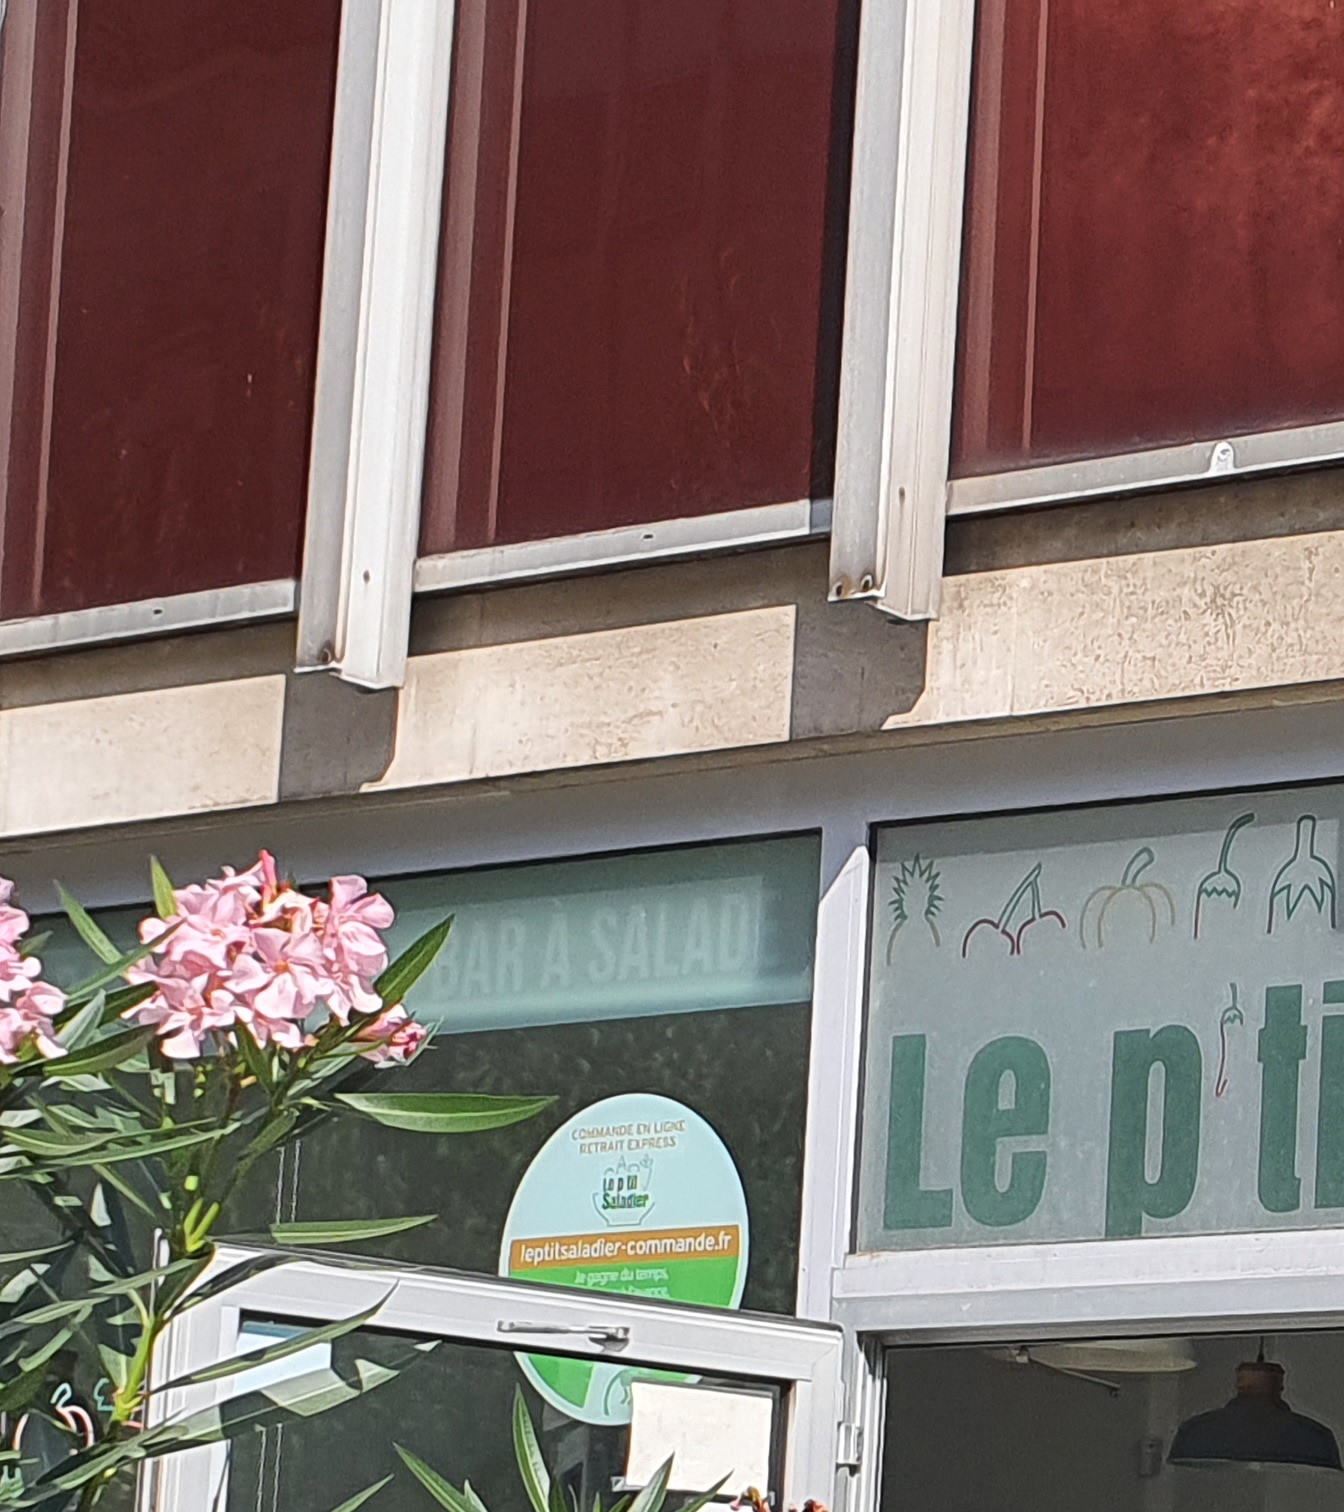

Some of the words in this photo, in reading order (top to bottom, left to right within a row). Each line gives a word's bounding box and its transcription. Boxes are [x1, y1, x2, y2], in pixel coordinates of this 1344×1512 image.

[571, 1123, 634, 1141] COMMANDE
[636, 1122, 651, 1134] EN
[654, 1119, 686, 1133] LIGNE
[883, 1033, 1050, 1230] Le
[579, 1139, 624, 1155] RETRAIT
[627, 1136, 677, 1151] EXPRESS
[601, 1193, 649, 1210] Saladier
[520, 1231, 732, 1265] leptitsaladier-commande.fr
